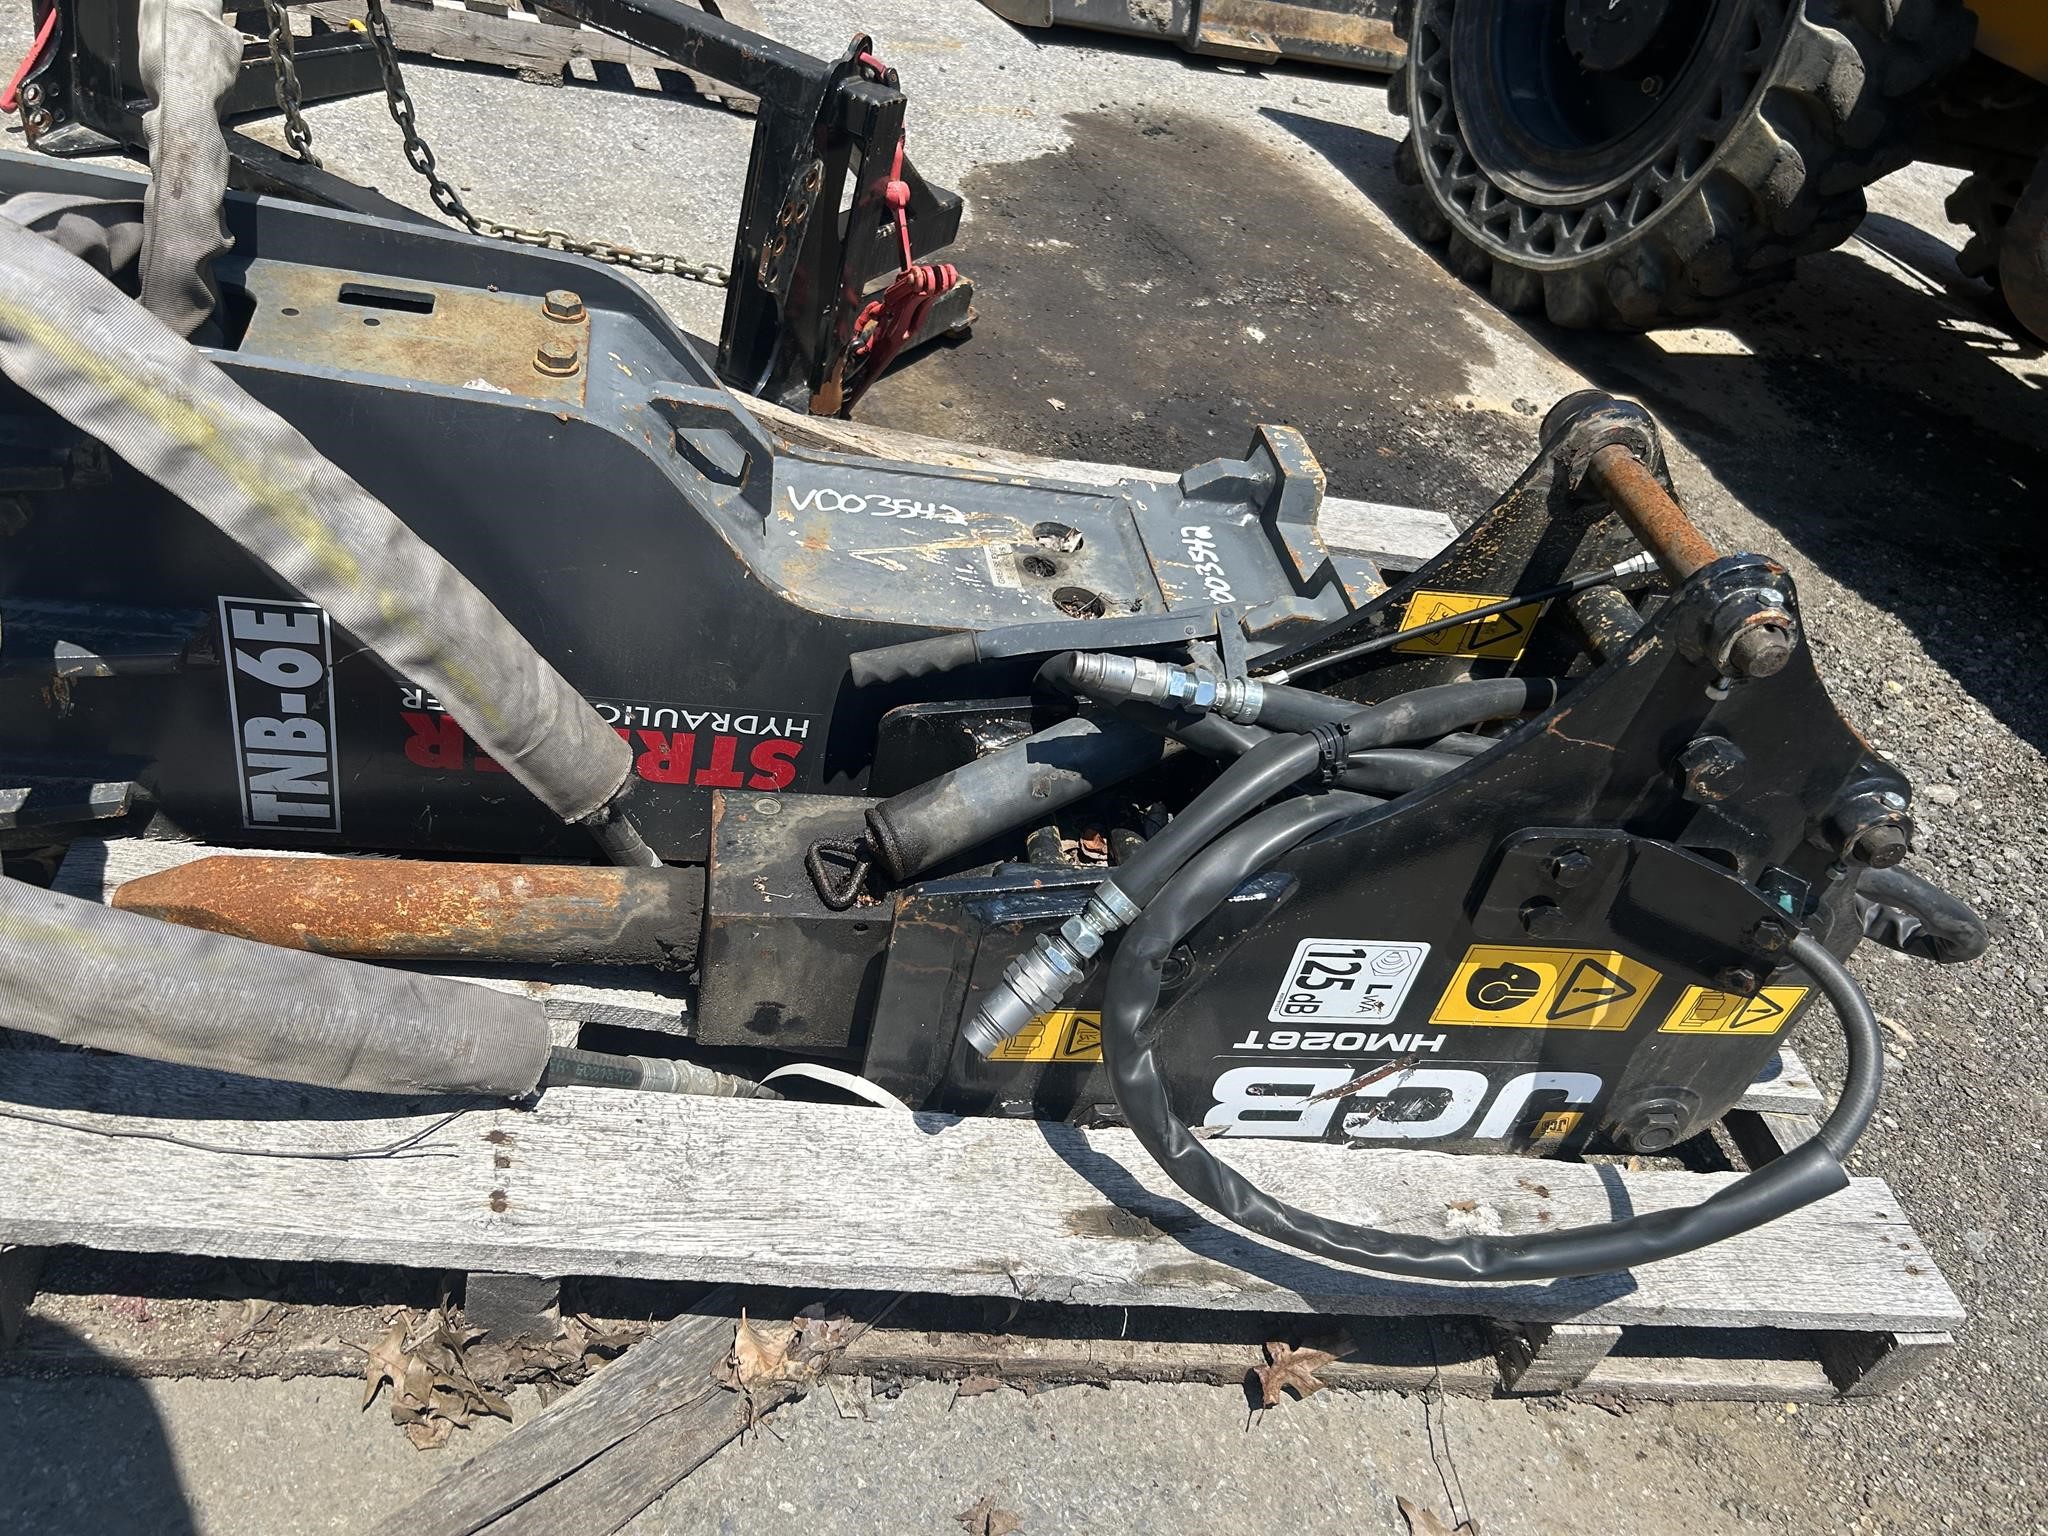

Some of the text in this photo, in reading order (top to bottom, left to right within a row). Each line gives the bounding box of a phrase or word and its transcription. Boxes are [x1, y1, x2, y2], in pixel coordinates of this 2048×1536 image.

[1180, 525, 1236, 605] 003542
[231, 609, 331, 822] TNB-6E
[596, 704, 810, 738] HYDRAULIC
[1284, 948, 1367, 1014] 125 dB
[1234, 1031, 1446, 1052] HM026T
[1203, 1066, 1602, 1138] JCB
